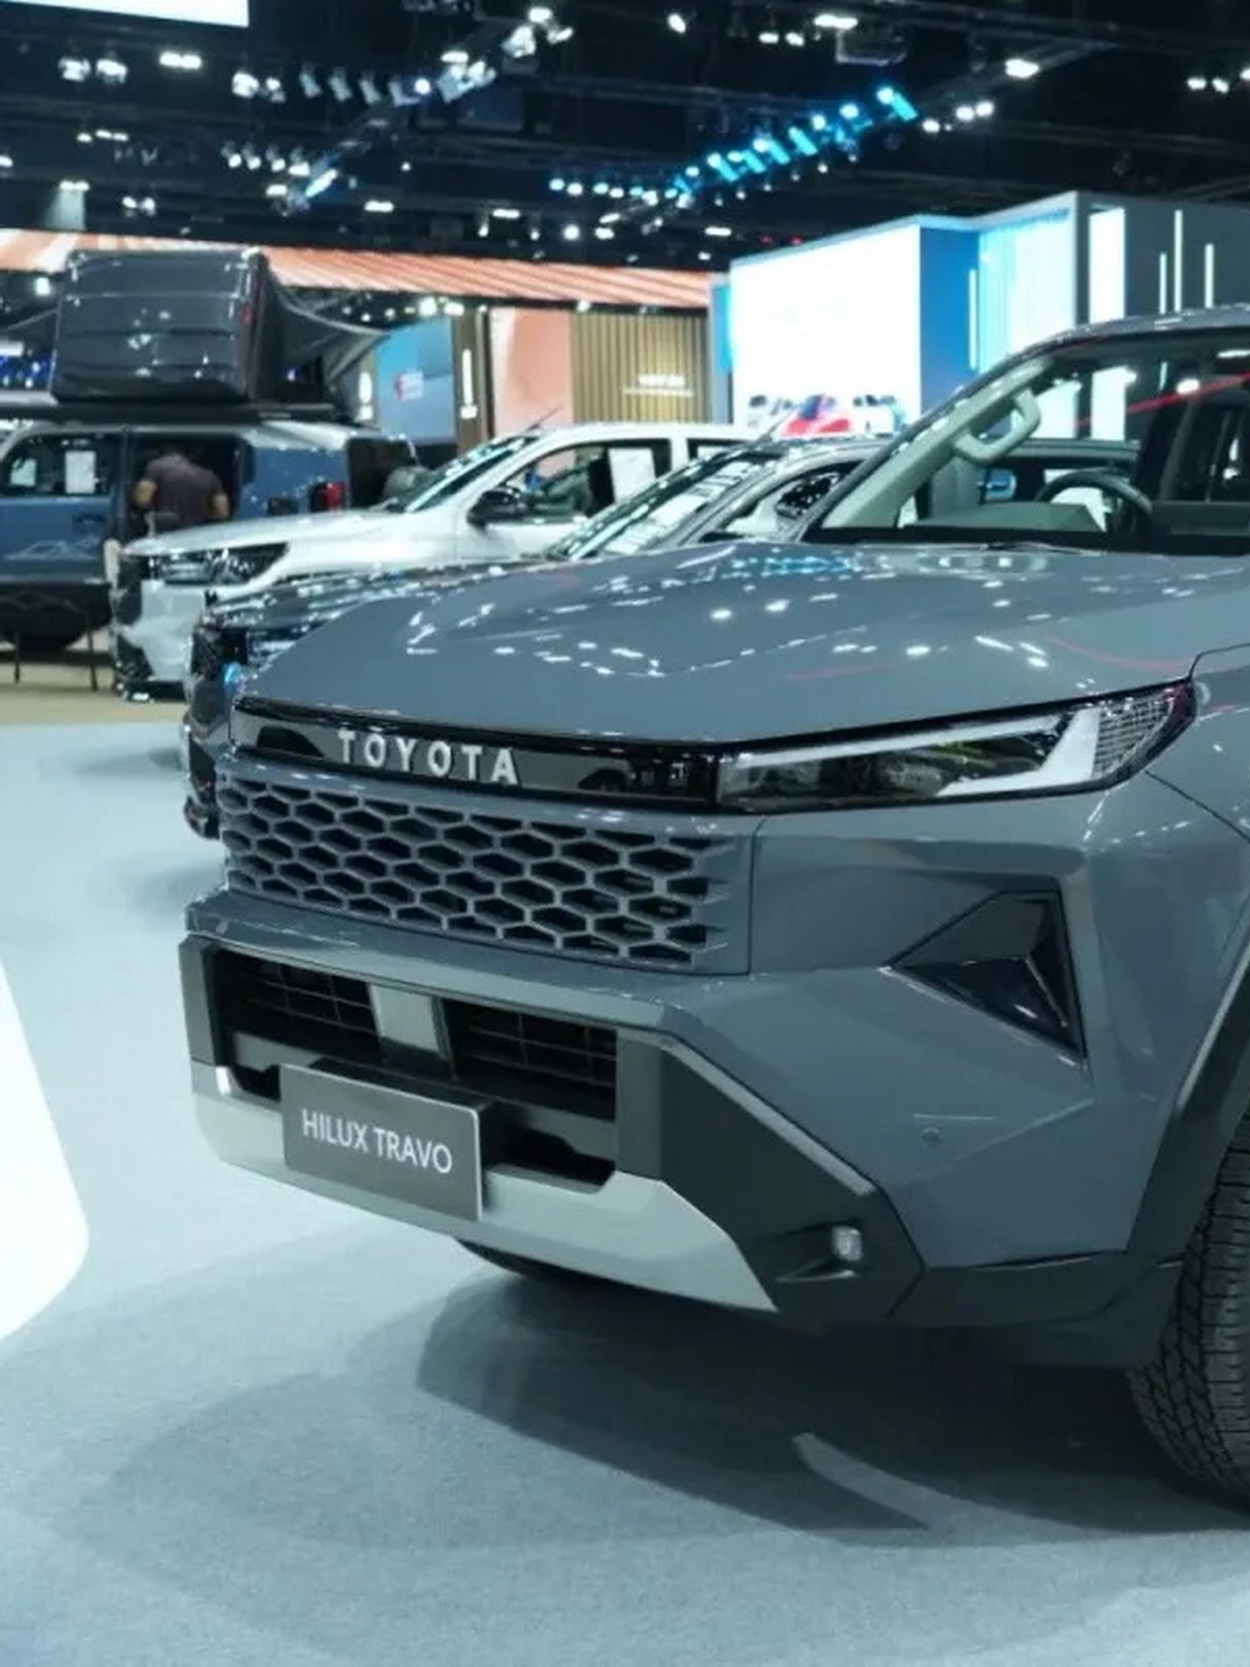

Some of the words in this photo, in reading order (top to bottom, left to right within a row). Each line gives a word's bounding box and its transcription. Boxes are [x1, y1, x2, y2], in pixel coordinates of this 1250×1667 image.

[337, 728, 518, 786] TOYOTA
[301, 1108, 369, 1154] HILUX
[372, 1126, 453, 1175] TRAVO
